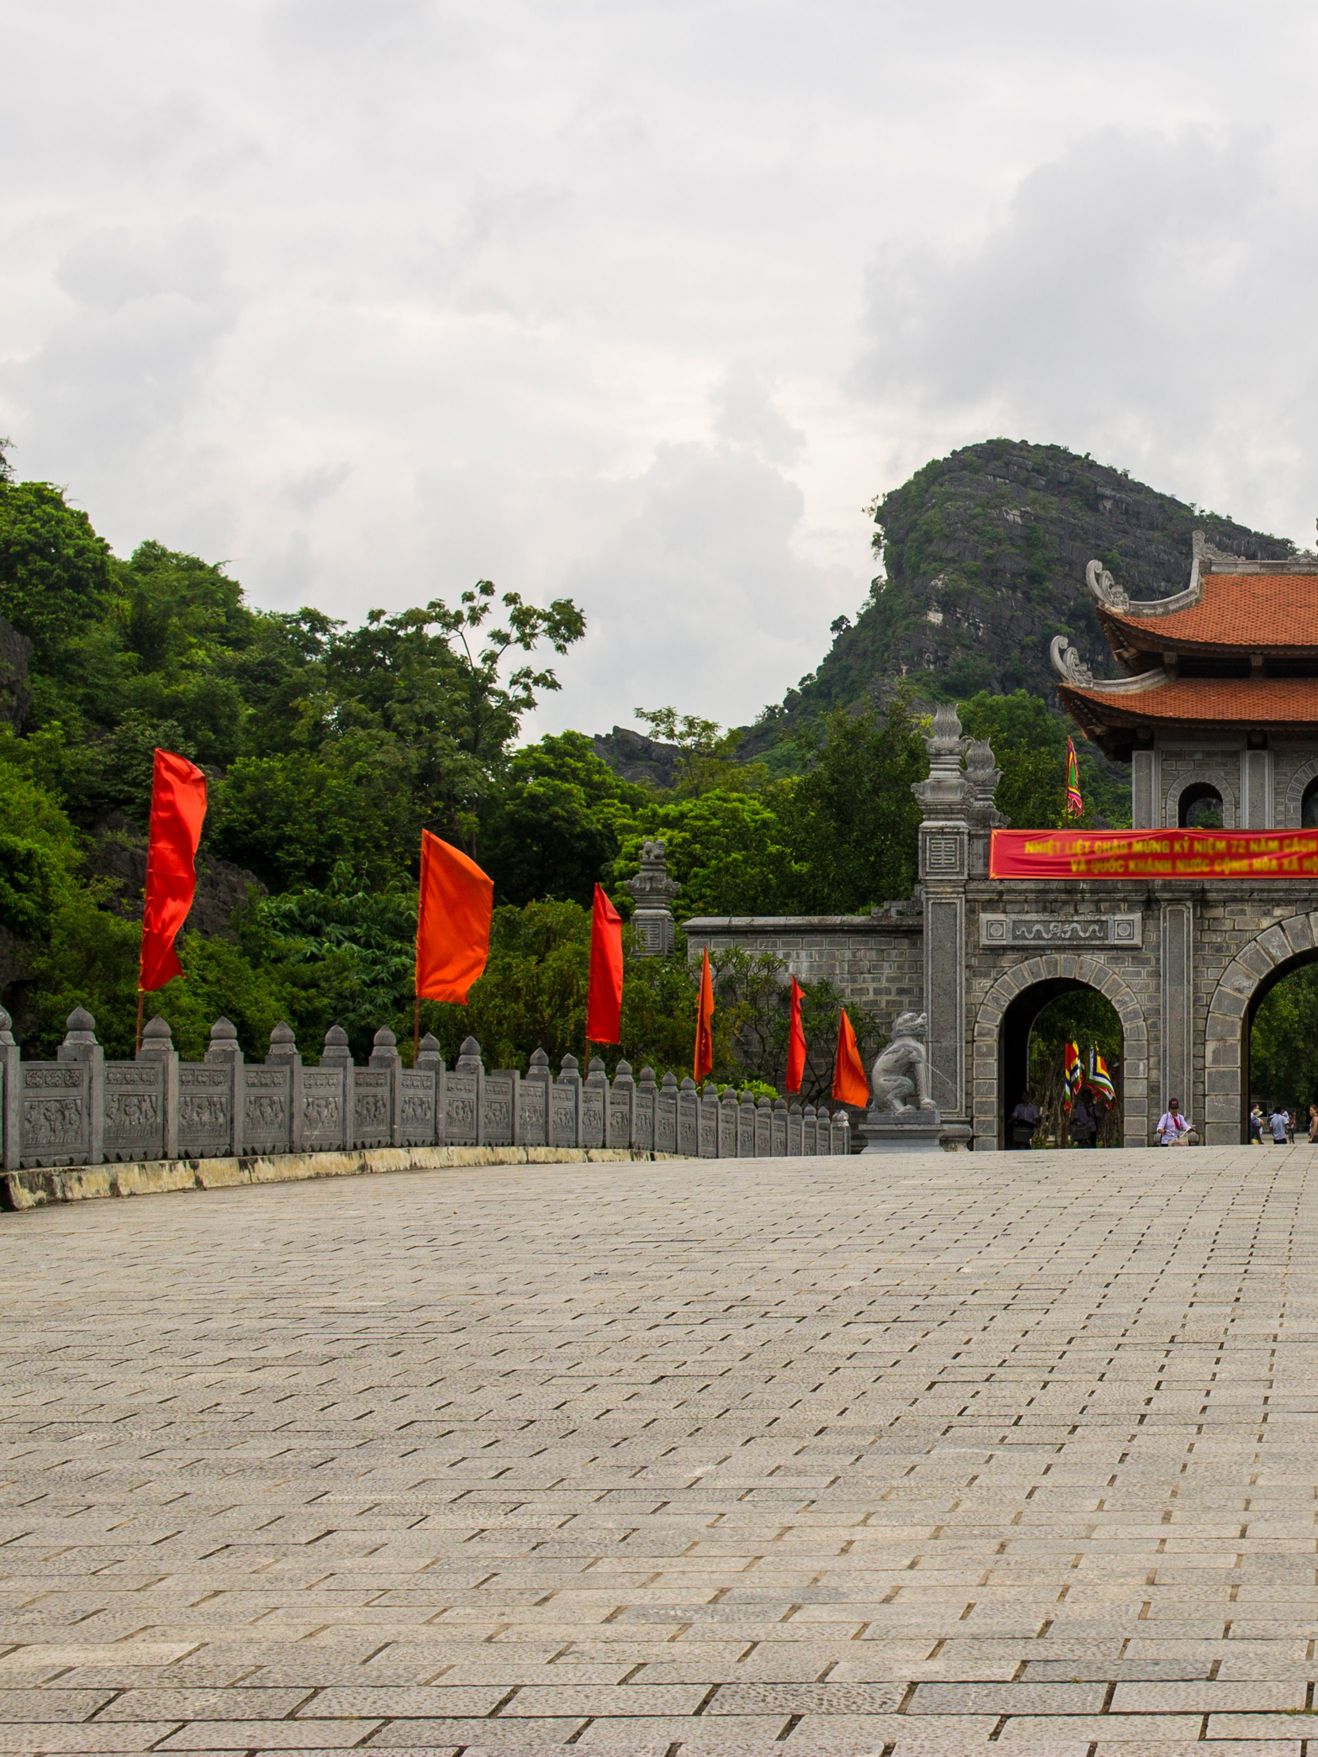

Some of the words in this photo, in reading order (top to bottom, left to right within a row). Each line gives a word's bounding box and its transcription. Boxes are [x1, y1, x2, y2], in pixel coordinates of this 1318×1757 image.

[1024, 839, 1060, 856] NHIỆT
[1065, 839, 1090, 855] LIỆT
[1094, 838, 1128, 853] CHÀO
[1174, 836, 1190, 853] KỶ
[1194, 837, 1226, 855] NIỆM
[1231, 840, 1246, 853] 72
[1250, 838, 1279, 853] NĂM
[1283, 837, 1317, 852] CÁCH
[1071, 857, 1087, 872] VÀ
[1091, 857, 1125, 873] QUỐC
[1128, 857, 1172, 872] KHÁNH
[1214, 857, 1249, 874] CỘNG
